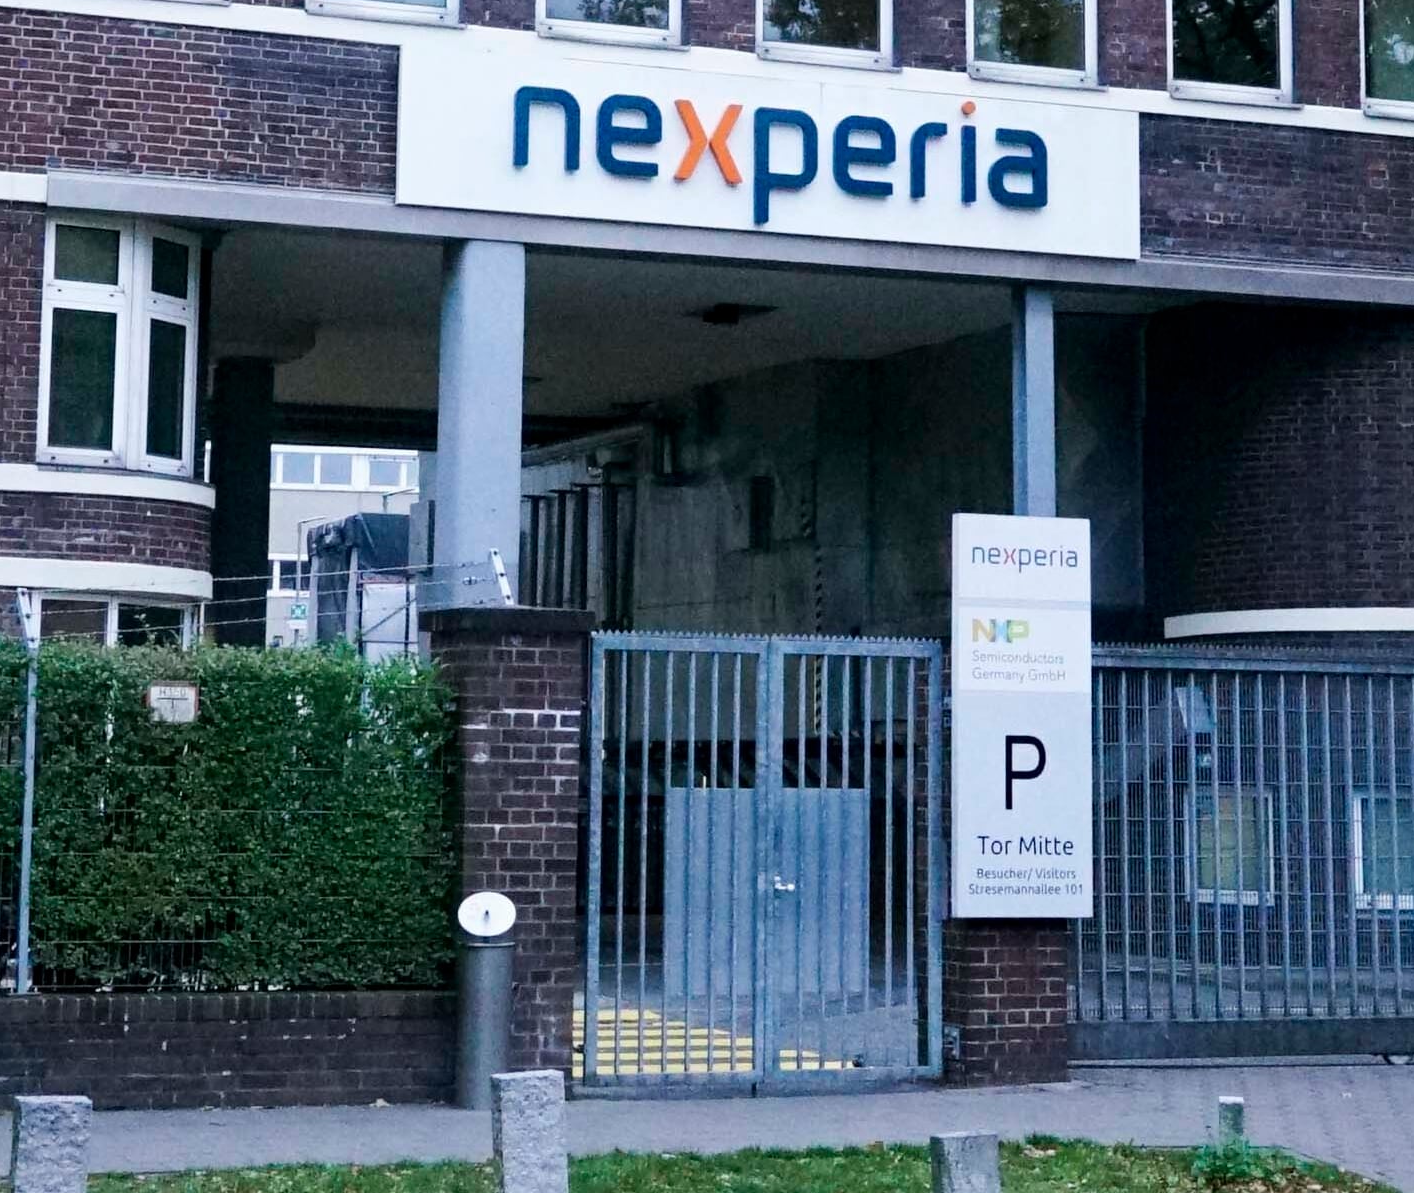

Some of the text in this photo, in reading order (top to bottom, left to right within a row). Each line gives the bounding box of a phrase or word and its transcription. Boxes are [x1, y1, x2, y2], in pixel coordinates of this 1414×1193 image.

[512, 85, 1049, 225] nexperia
[971, 545, 1078, 573] nexperia
[971, 618, 1030, 644] NXP
[971, 649, 1065, 665] Semiconductors
[971, 666, 1067, 685] Germany GmbH
[1004, 734, 1047, 810] P
[976, 835, 1075, 856] Tor Mitte
[976, 867, 1077, 882] Besucher/ Visitors
[968, 883, 1084, 896] Stresemannallee 101
